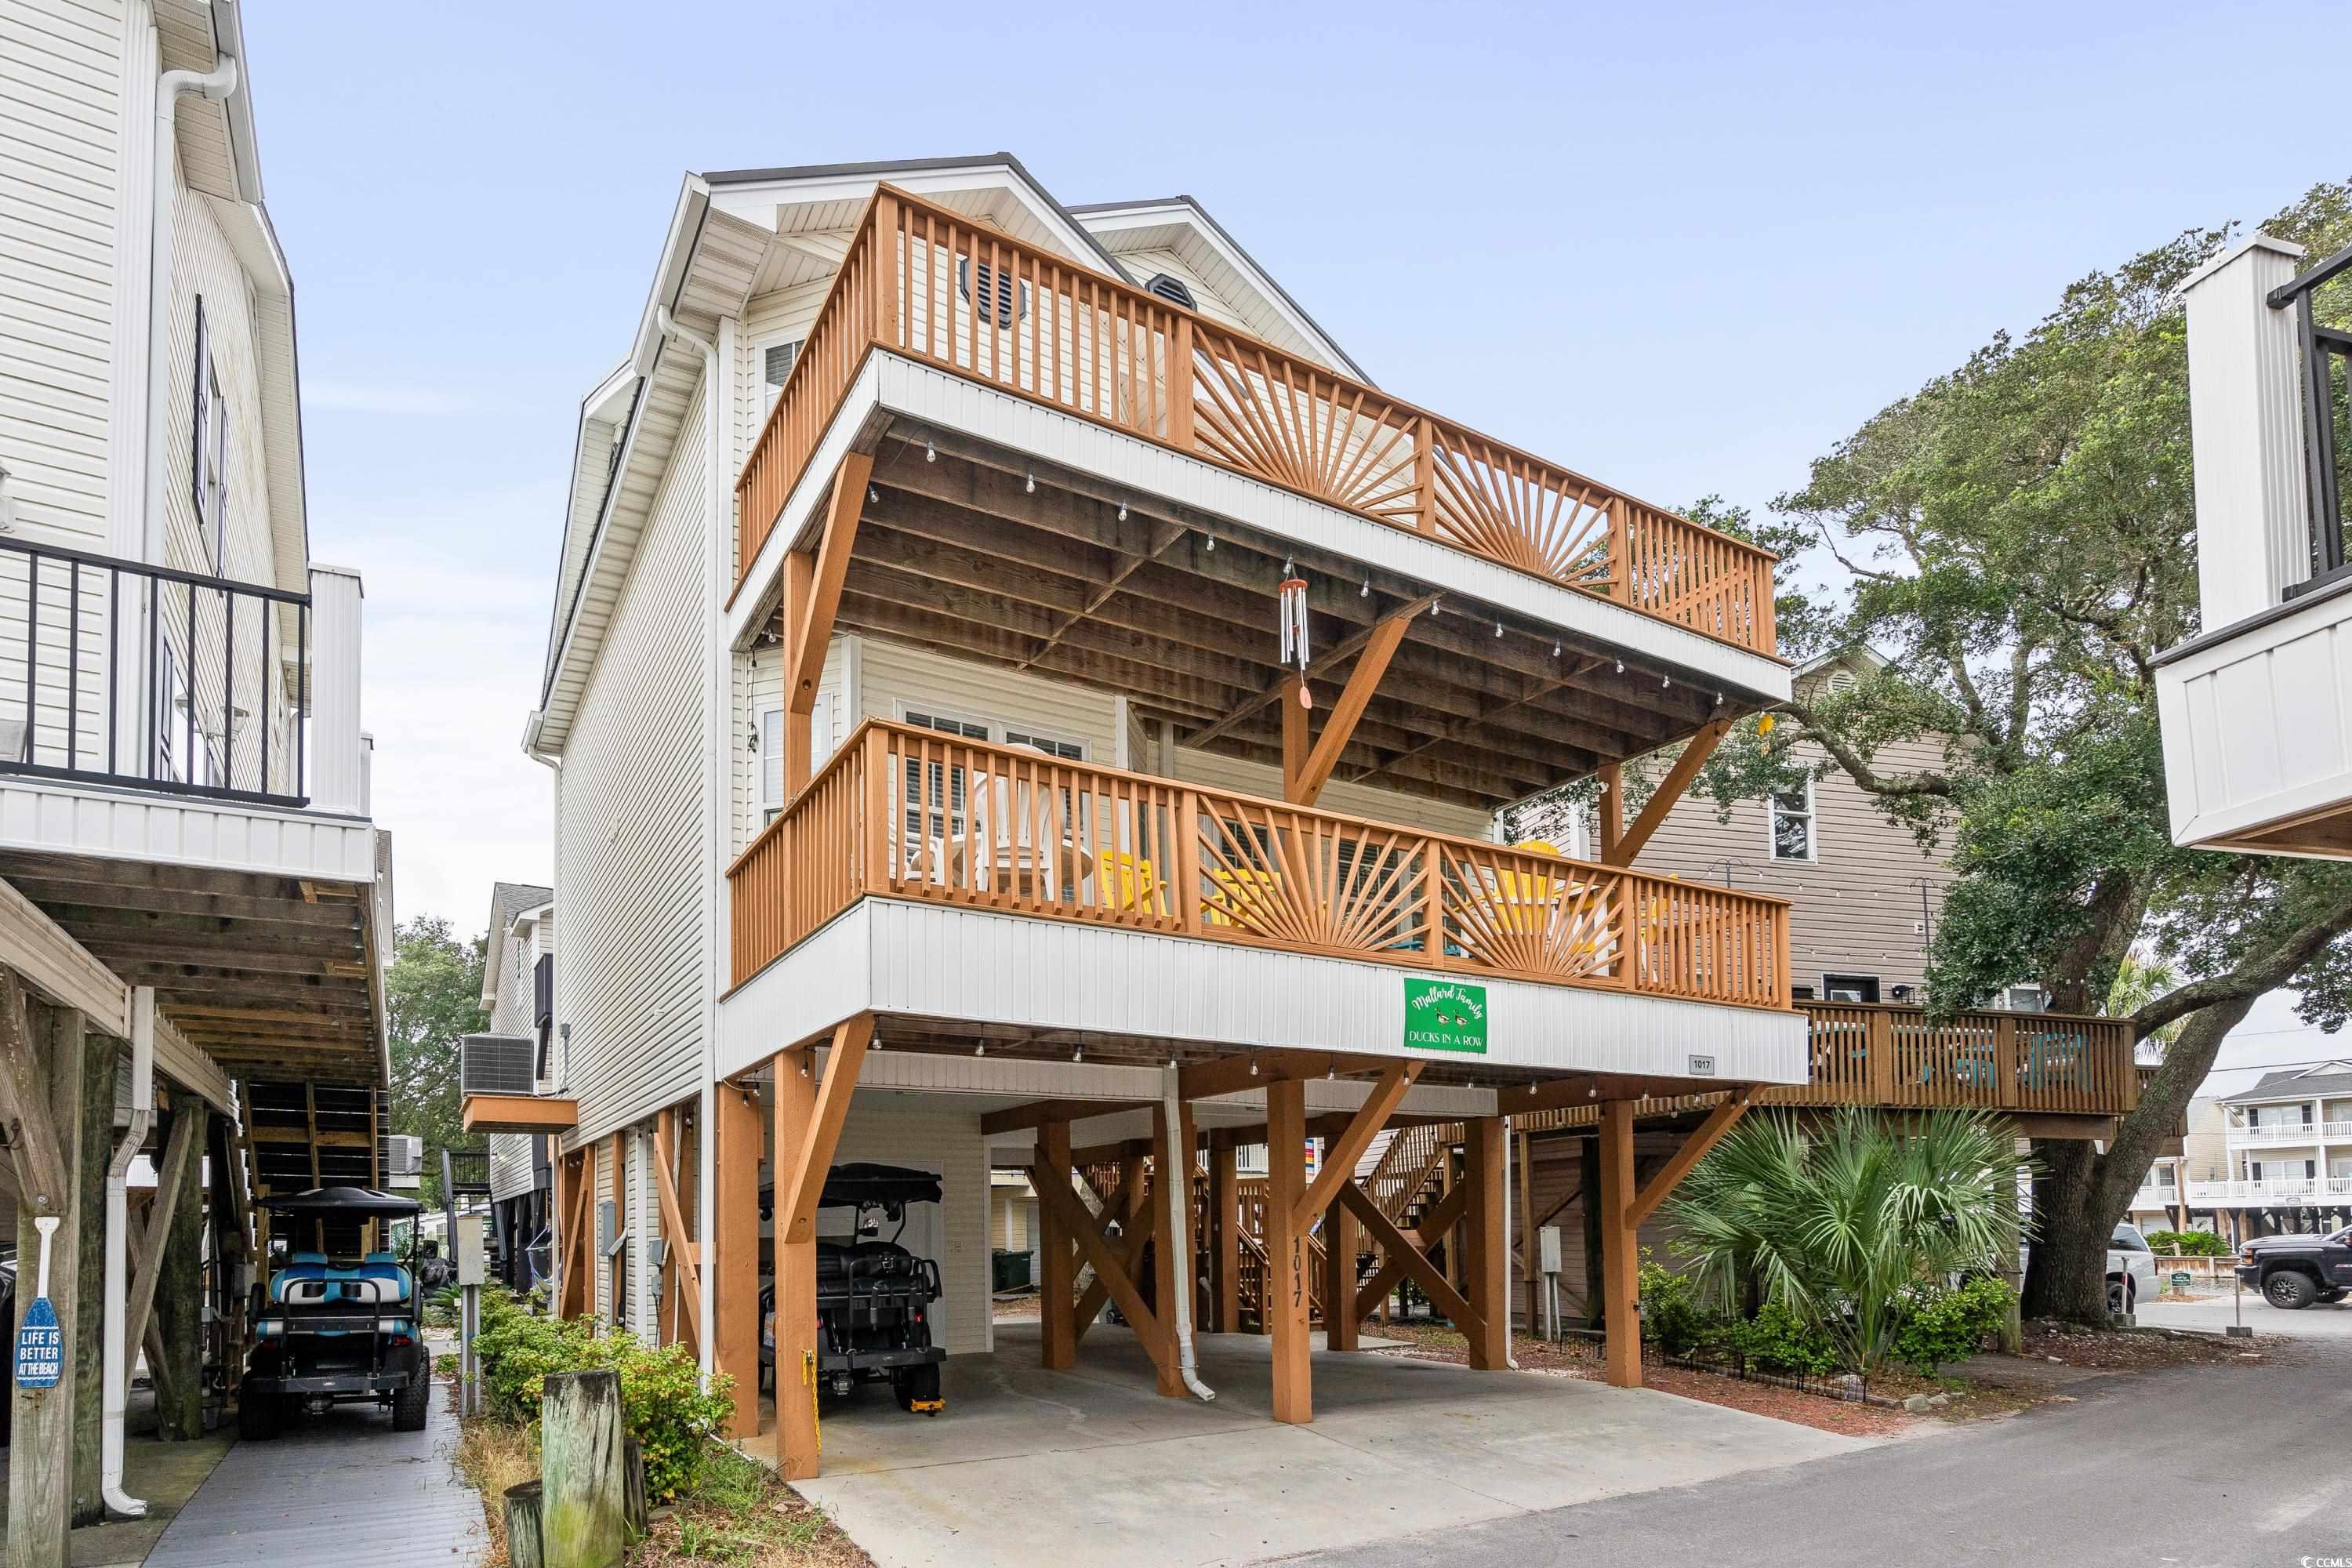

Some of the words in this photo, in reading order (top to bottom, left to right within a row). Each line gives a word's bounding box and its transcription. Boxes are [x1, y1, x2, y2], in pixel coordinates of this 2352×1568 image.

[1411, 985, 1455, 1010] Mallard
[1456, 988, 1483, 1019] Family
[1409, 1031, 1439, 1043] DUCKS
[1442, 1033, 1451, 1044] IN
[1454, 1035, 1461, 1044] A
[1463, 1036, 1483, 1047] ROW
[1693, 1059, 1711, 1069] 1017
[1293, 1235, 1302, 1308] 1017
[21, 1332, 45, 1345] LIFE
[49, 1332, 59, 1345] IS
[20, 1347, 59, 1360] BETTER
[18, 1363, 27, 1375] AT
[27, 1363, 38, 1375] THE
[38, 1362, 59, 1375] BEACH
